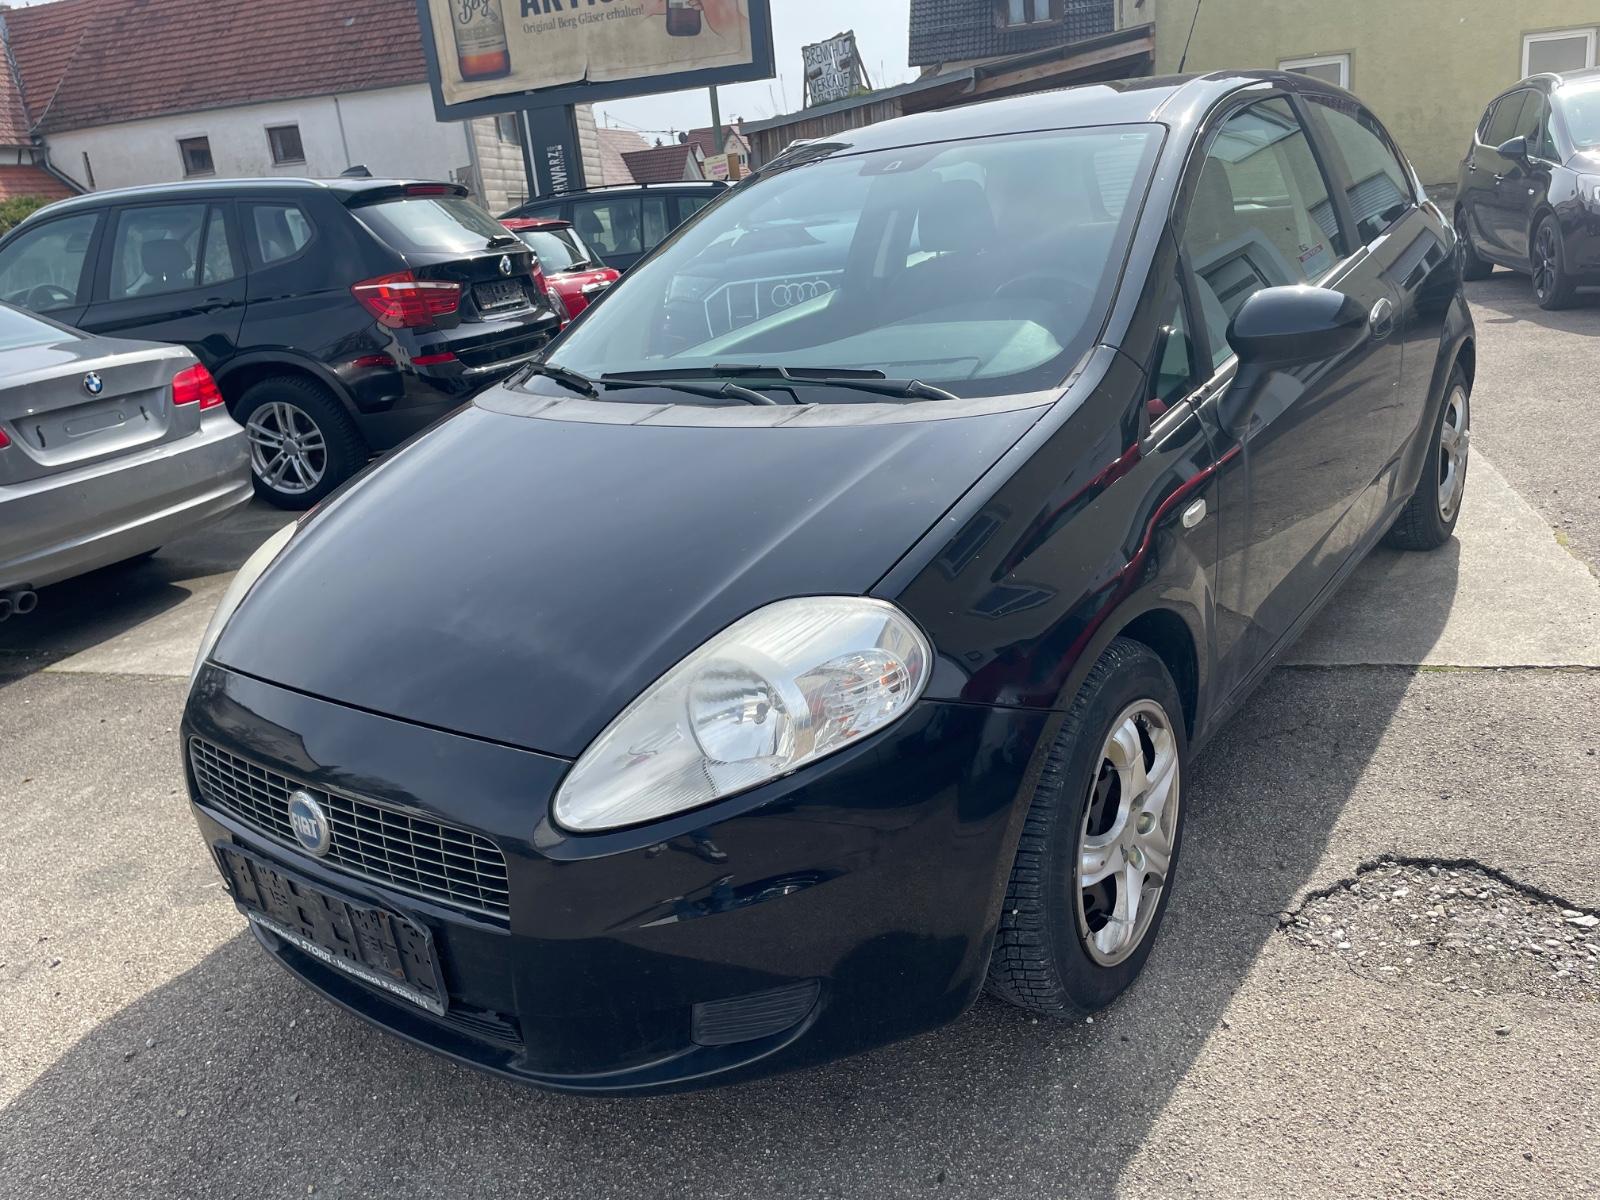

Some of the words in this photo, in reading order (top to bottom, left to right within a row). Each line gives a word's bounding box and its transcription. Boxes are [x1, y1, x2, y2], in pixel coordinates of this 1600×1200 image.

[523, 18, 556, 34] Original
[558, 18, 578, 29] Berg
[578, 12, 604, 25] Gläser
[606, 4, 644, 20] erhalten!
[292, 811, 317, 840] FIAT
